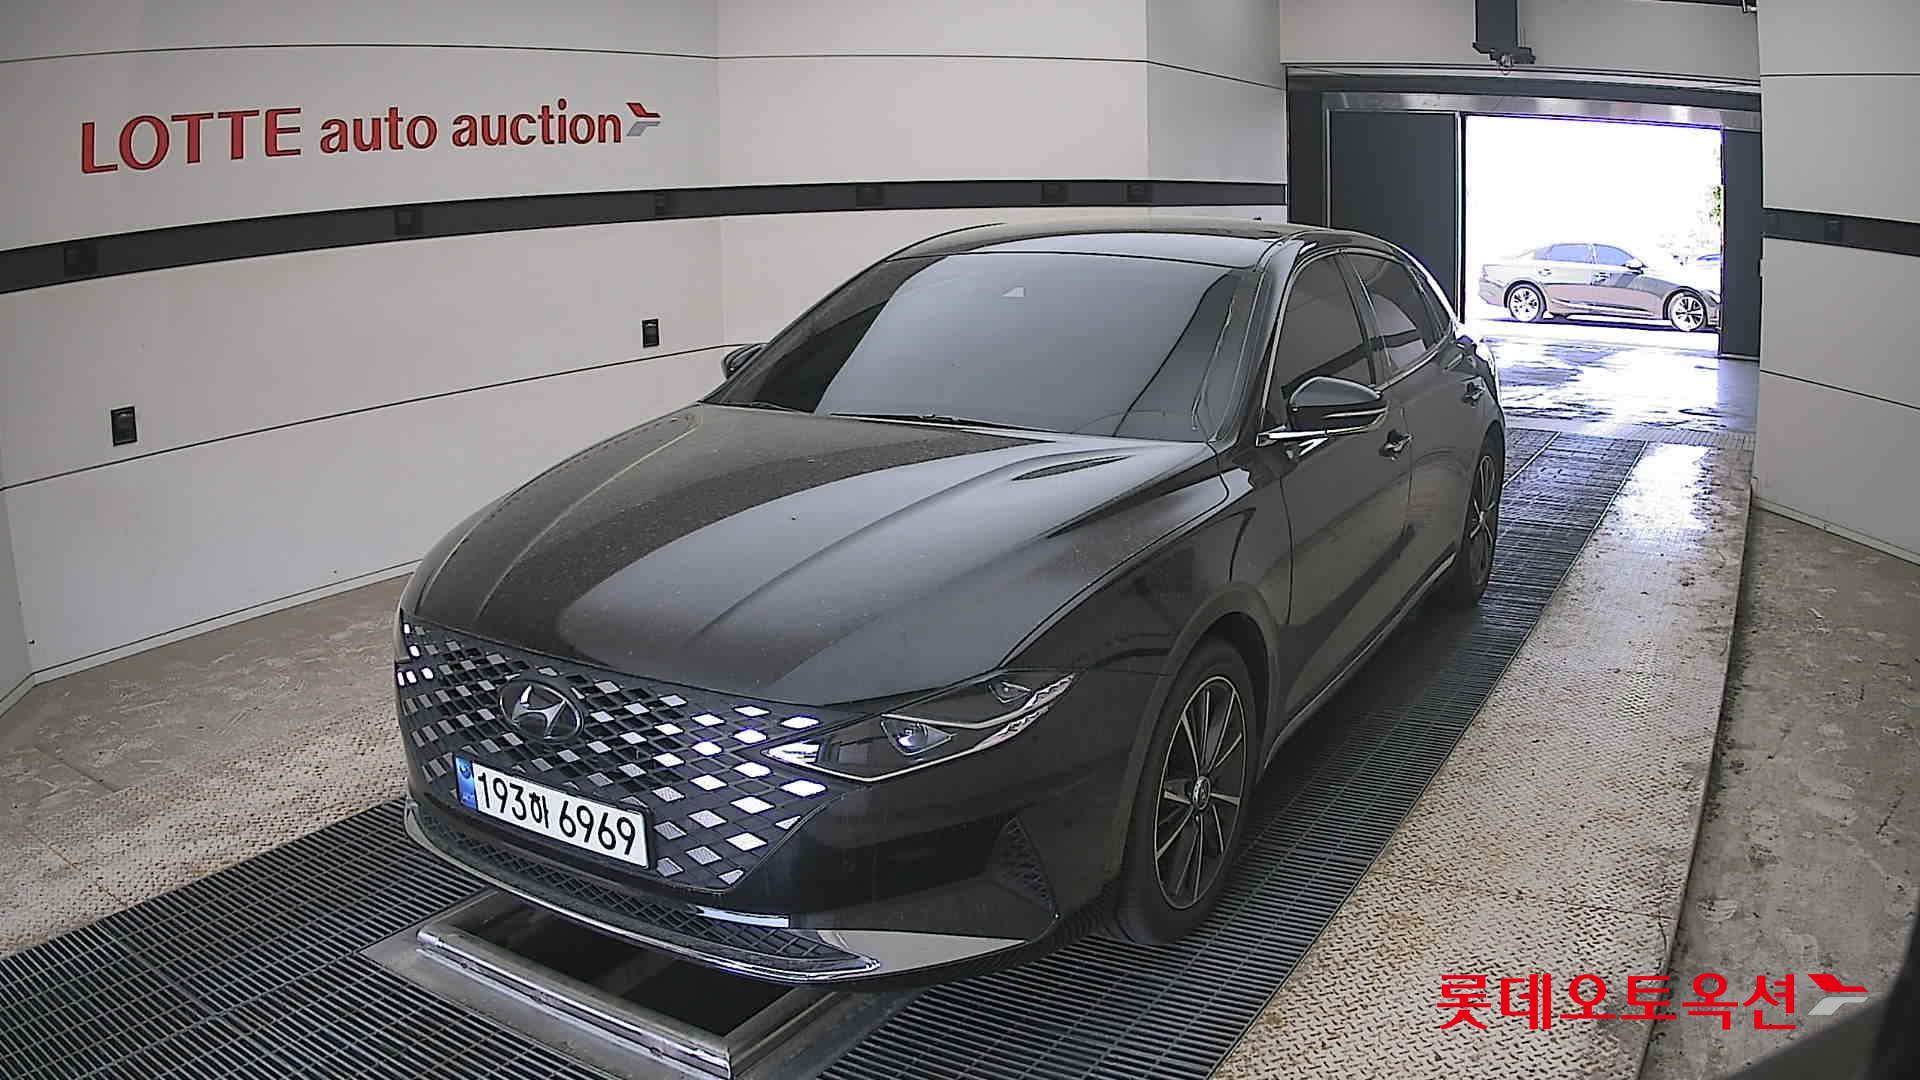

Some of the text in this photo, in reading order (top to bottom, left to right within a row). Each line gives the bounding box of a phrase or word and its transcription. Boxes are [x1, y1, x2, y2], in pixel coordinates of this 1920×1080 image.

[81, 98, 622, 174] LOTTE auto auction
[477, 772, 636, 855] 193하 6969
